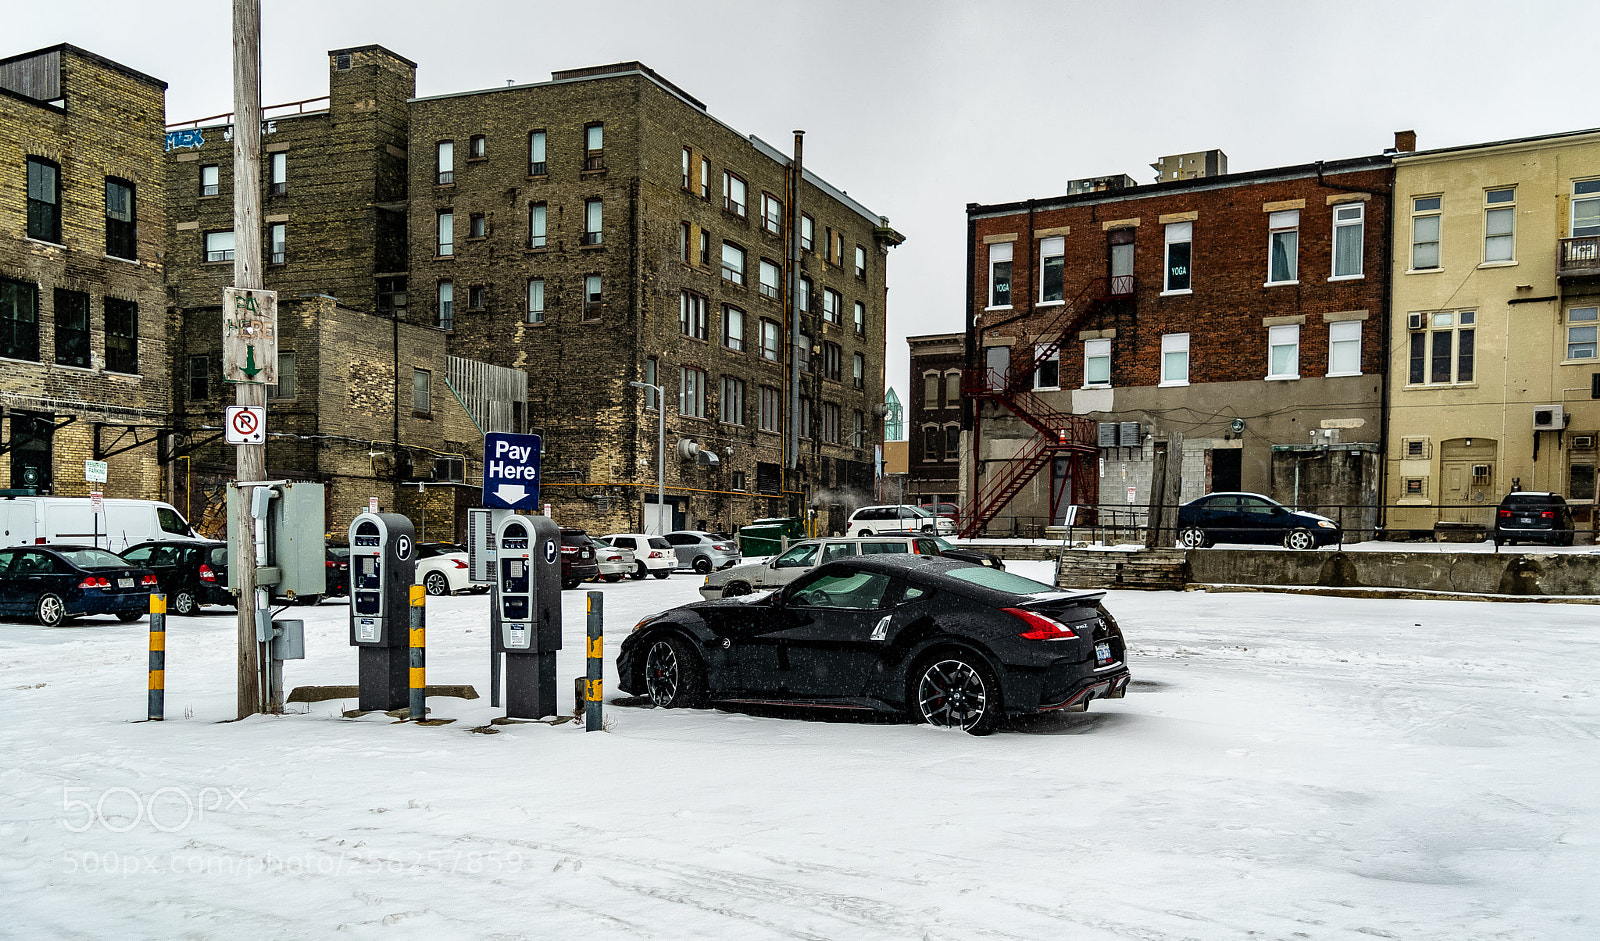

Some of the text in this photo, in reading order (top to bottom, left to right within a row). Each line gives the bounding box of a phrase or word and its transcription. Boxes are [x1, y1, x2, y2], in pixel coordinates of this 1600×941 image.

[1171, 266, 1187, 276] YOGA
[995, 283, 1010, 292] YOGA
[227, 318, 274, 339] HERE
[495, 440, 532, 464] Pay
[489, 460, 536, 480] Here
[399, 538, 409, 557] P
[547, 541, 555, 560] P
